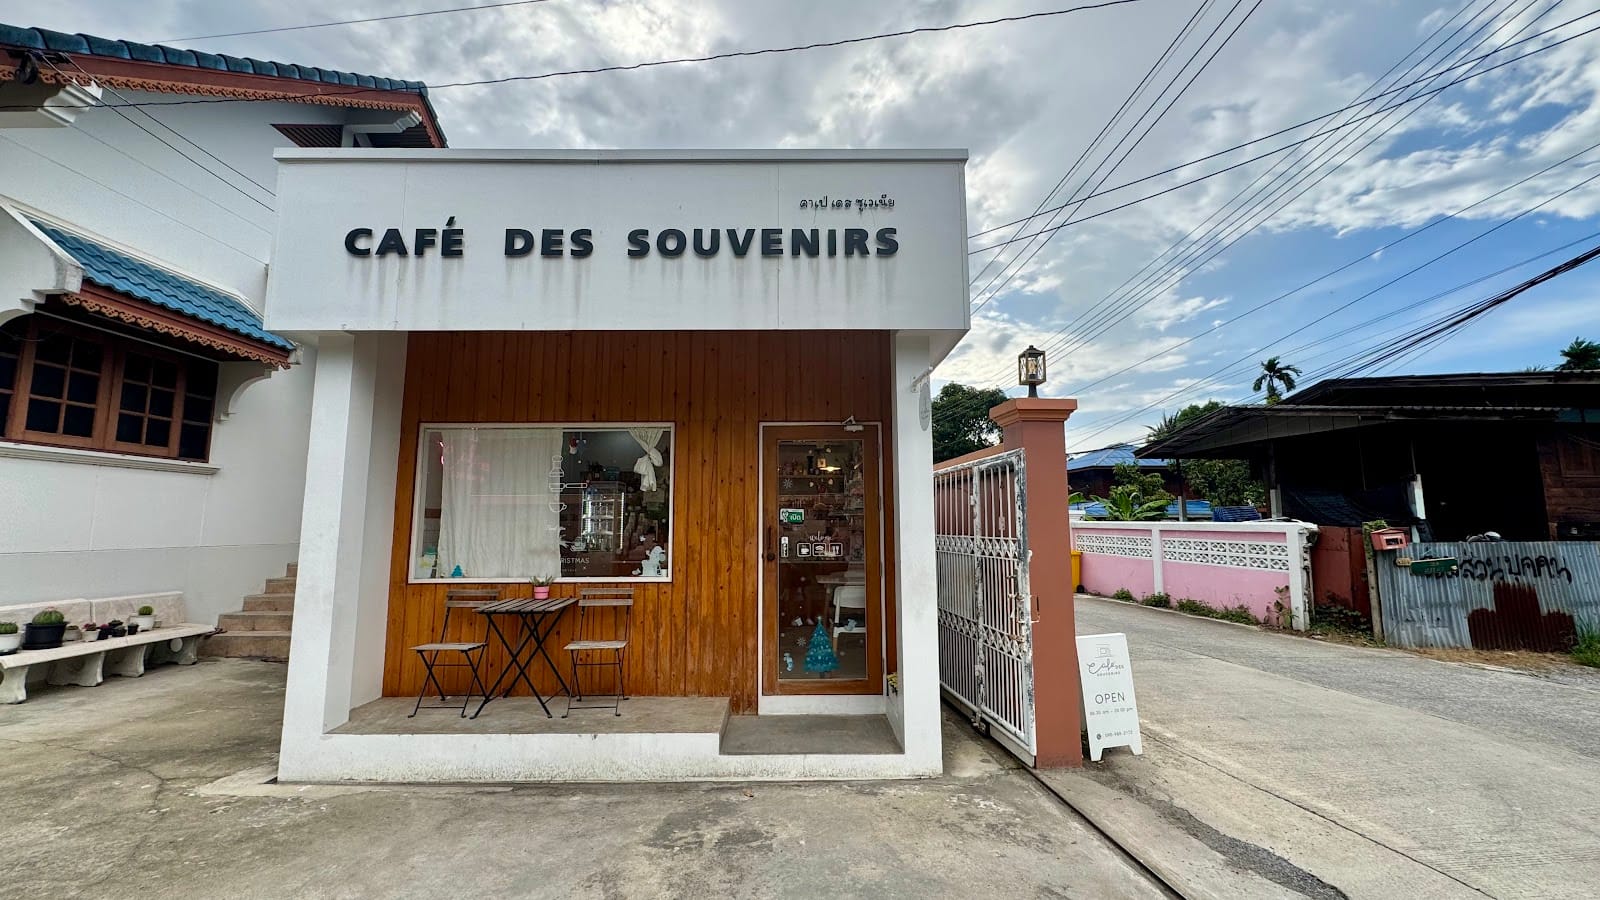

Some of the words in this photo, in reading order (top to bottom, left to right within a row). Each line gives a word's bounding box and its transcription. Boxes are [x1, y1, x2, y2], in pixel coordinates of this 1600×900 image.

[344, 215, 464, 257] CAFÉ
[504, 228, 594, 257] DES
[627, 227, 899, 257] SOUVENIRS
[1095, 692, 1125, 704] OPEN
